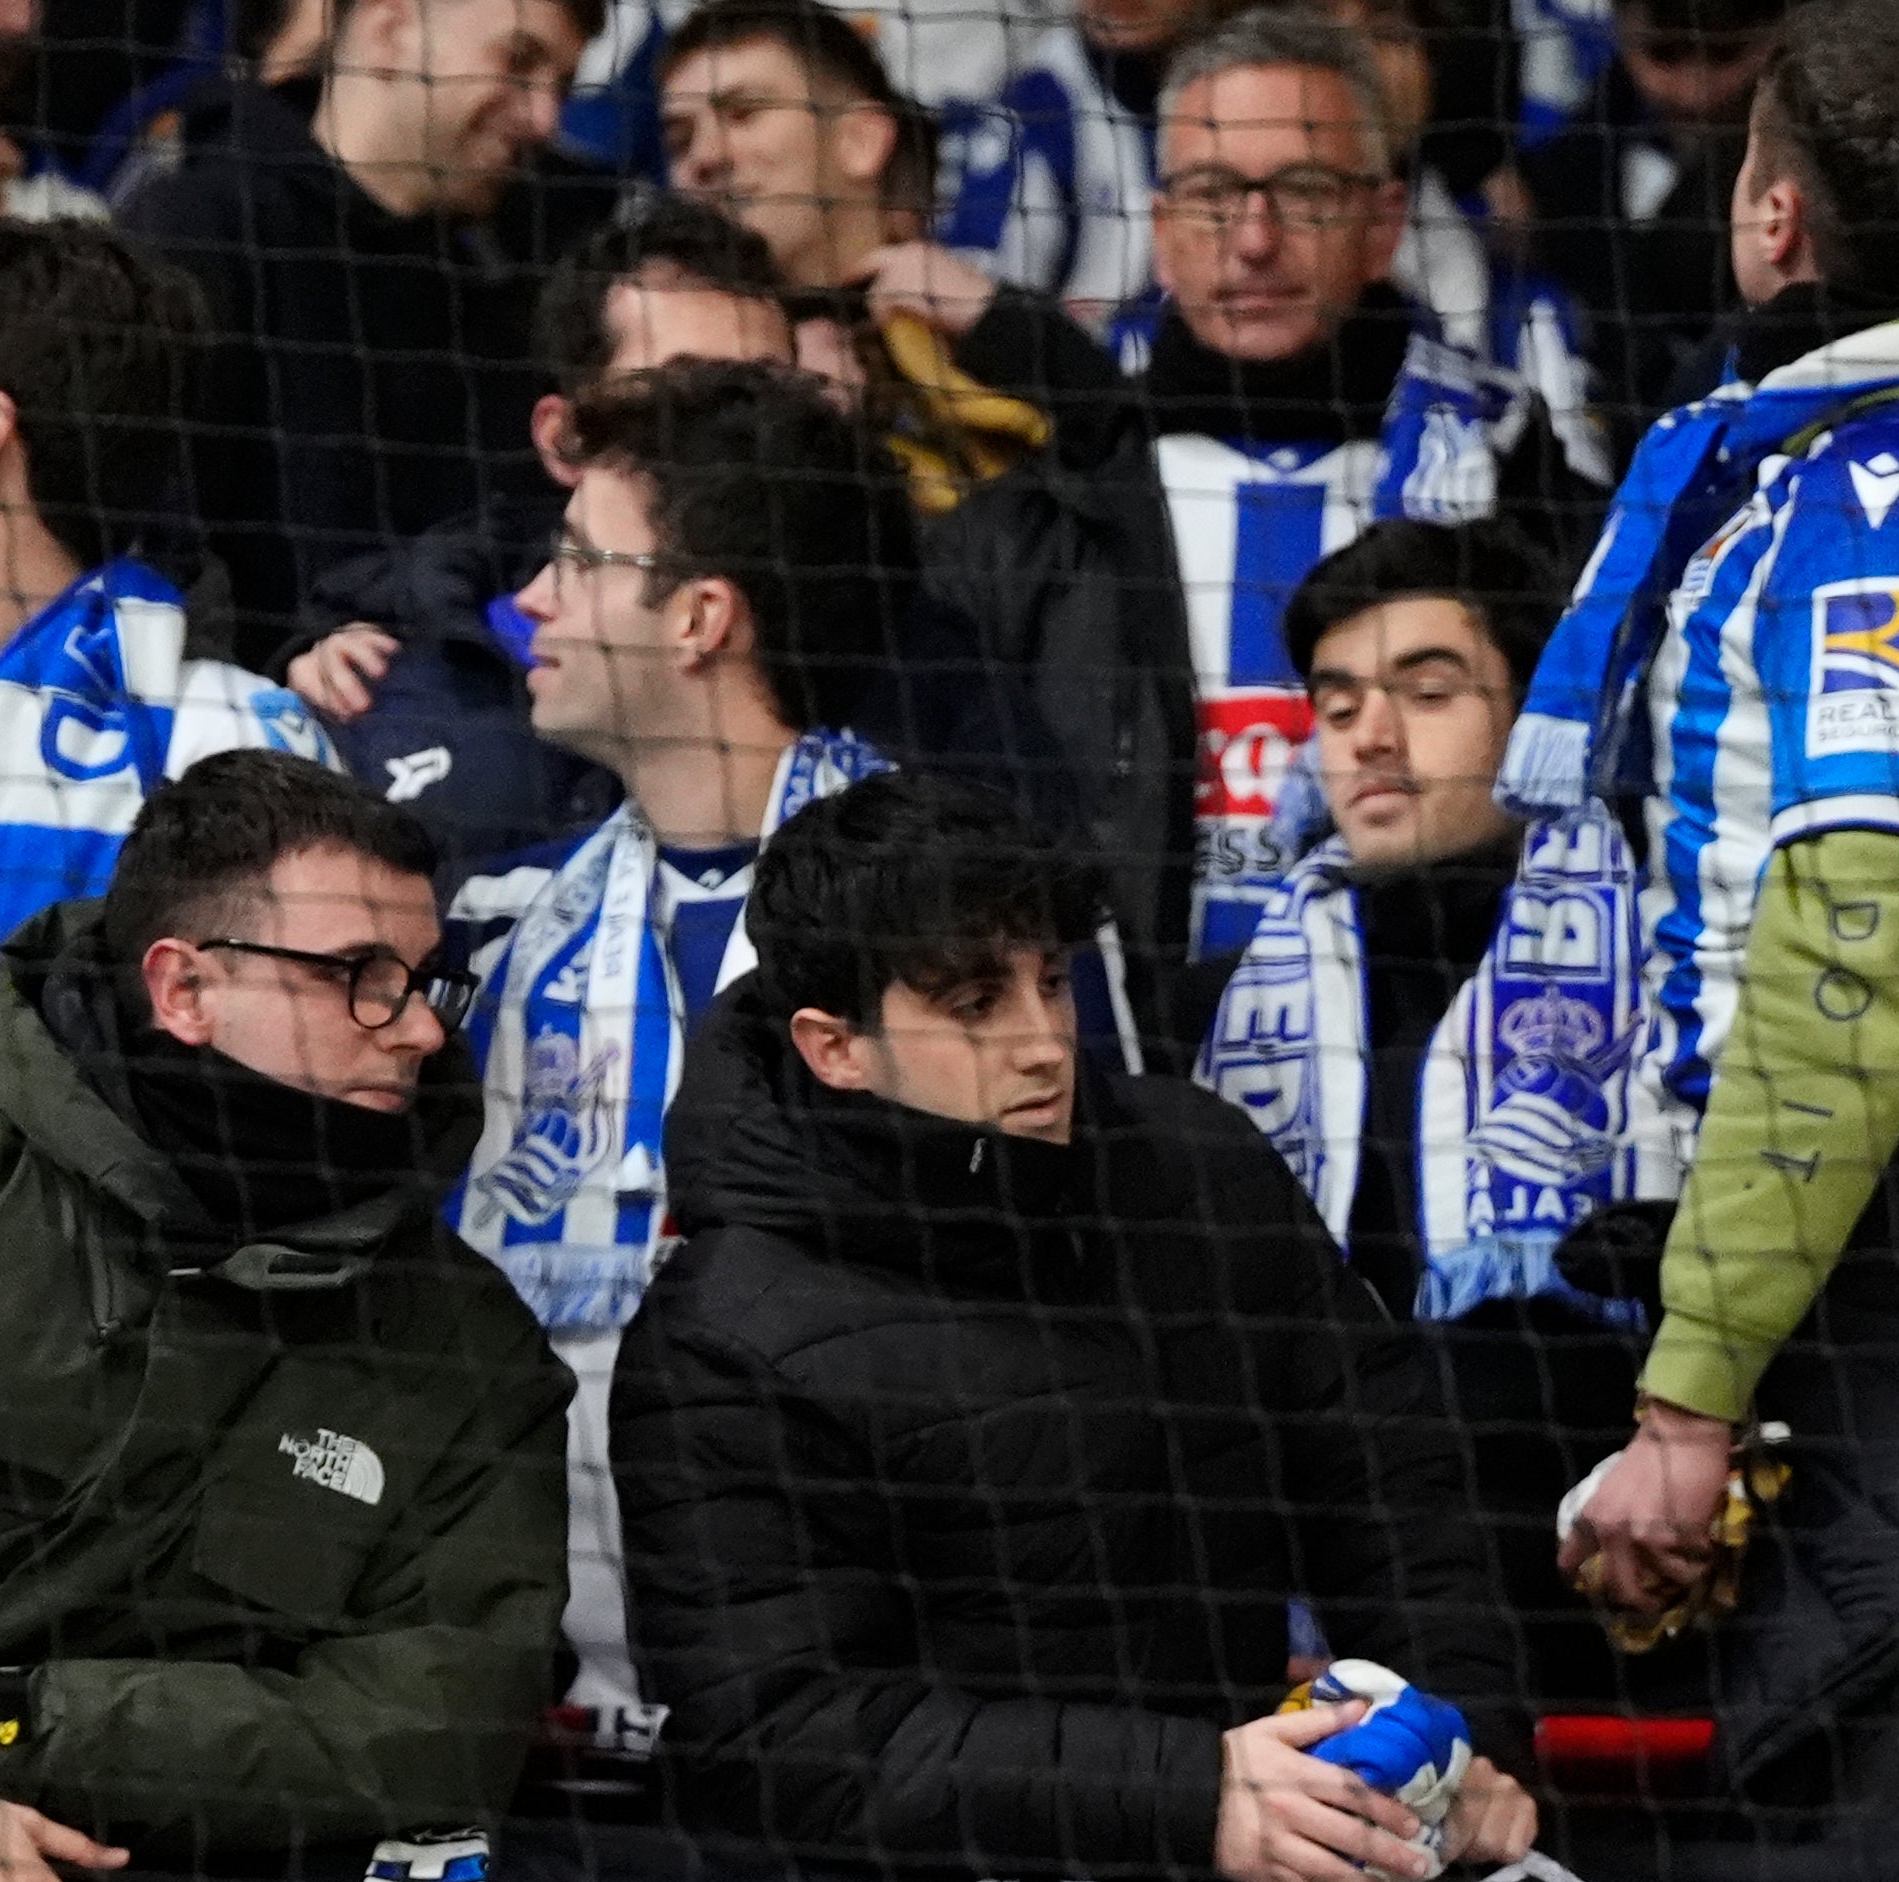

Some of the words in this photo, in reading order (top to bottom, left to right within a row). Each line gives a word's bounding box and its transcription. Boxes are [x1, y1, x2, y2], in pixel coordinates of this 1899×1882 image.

[278, 1433, 353, 1475] NORTH
[317, 1428, 355, 1454] THE
[292, 1456, 347, 1491] FACE
